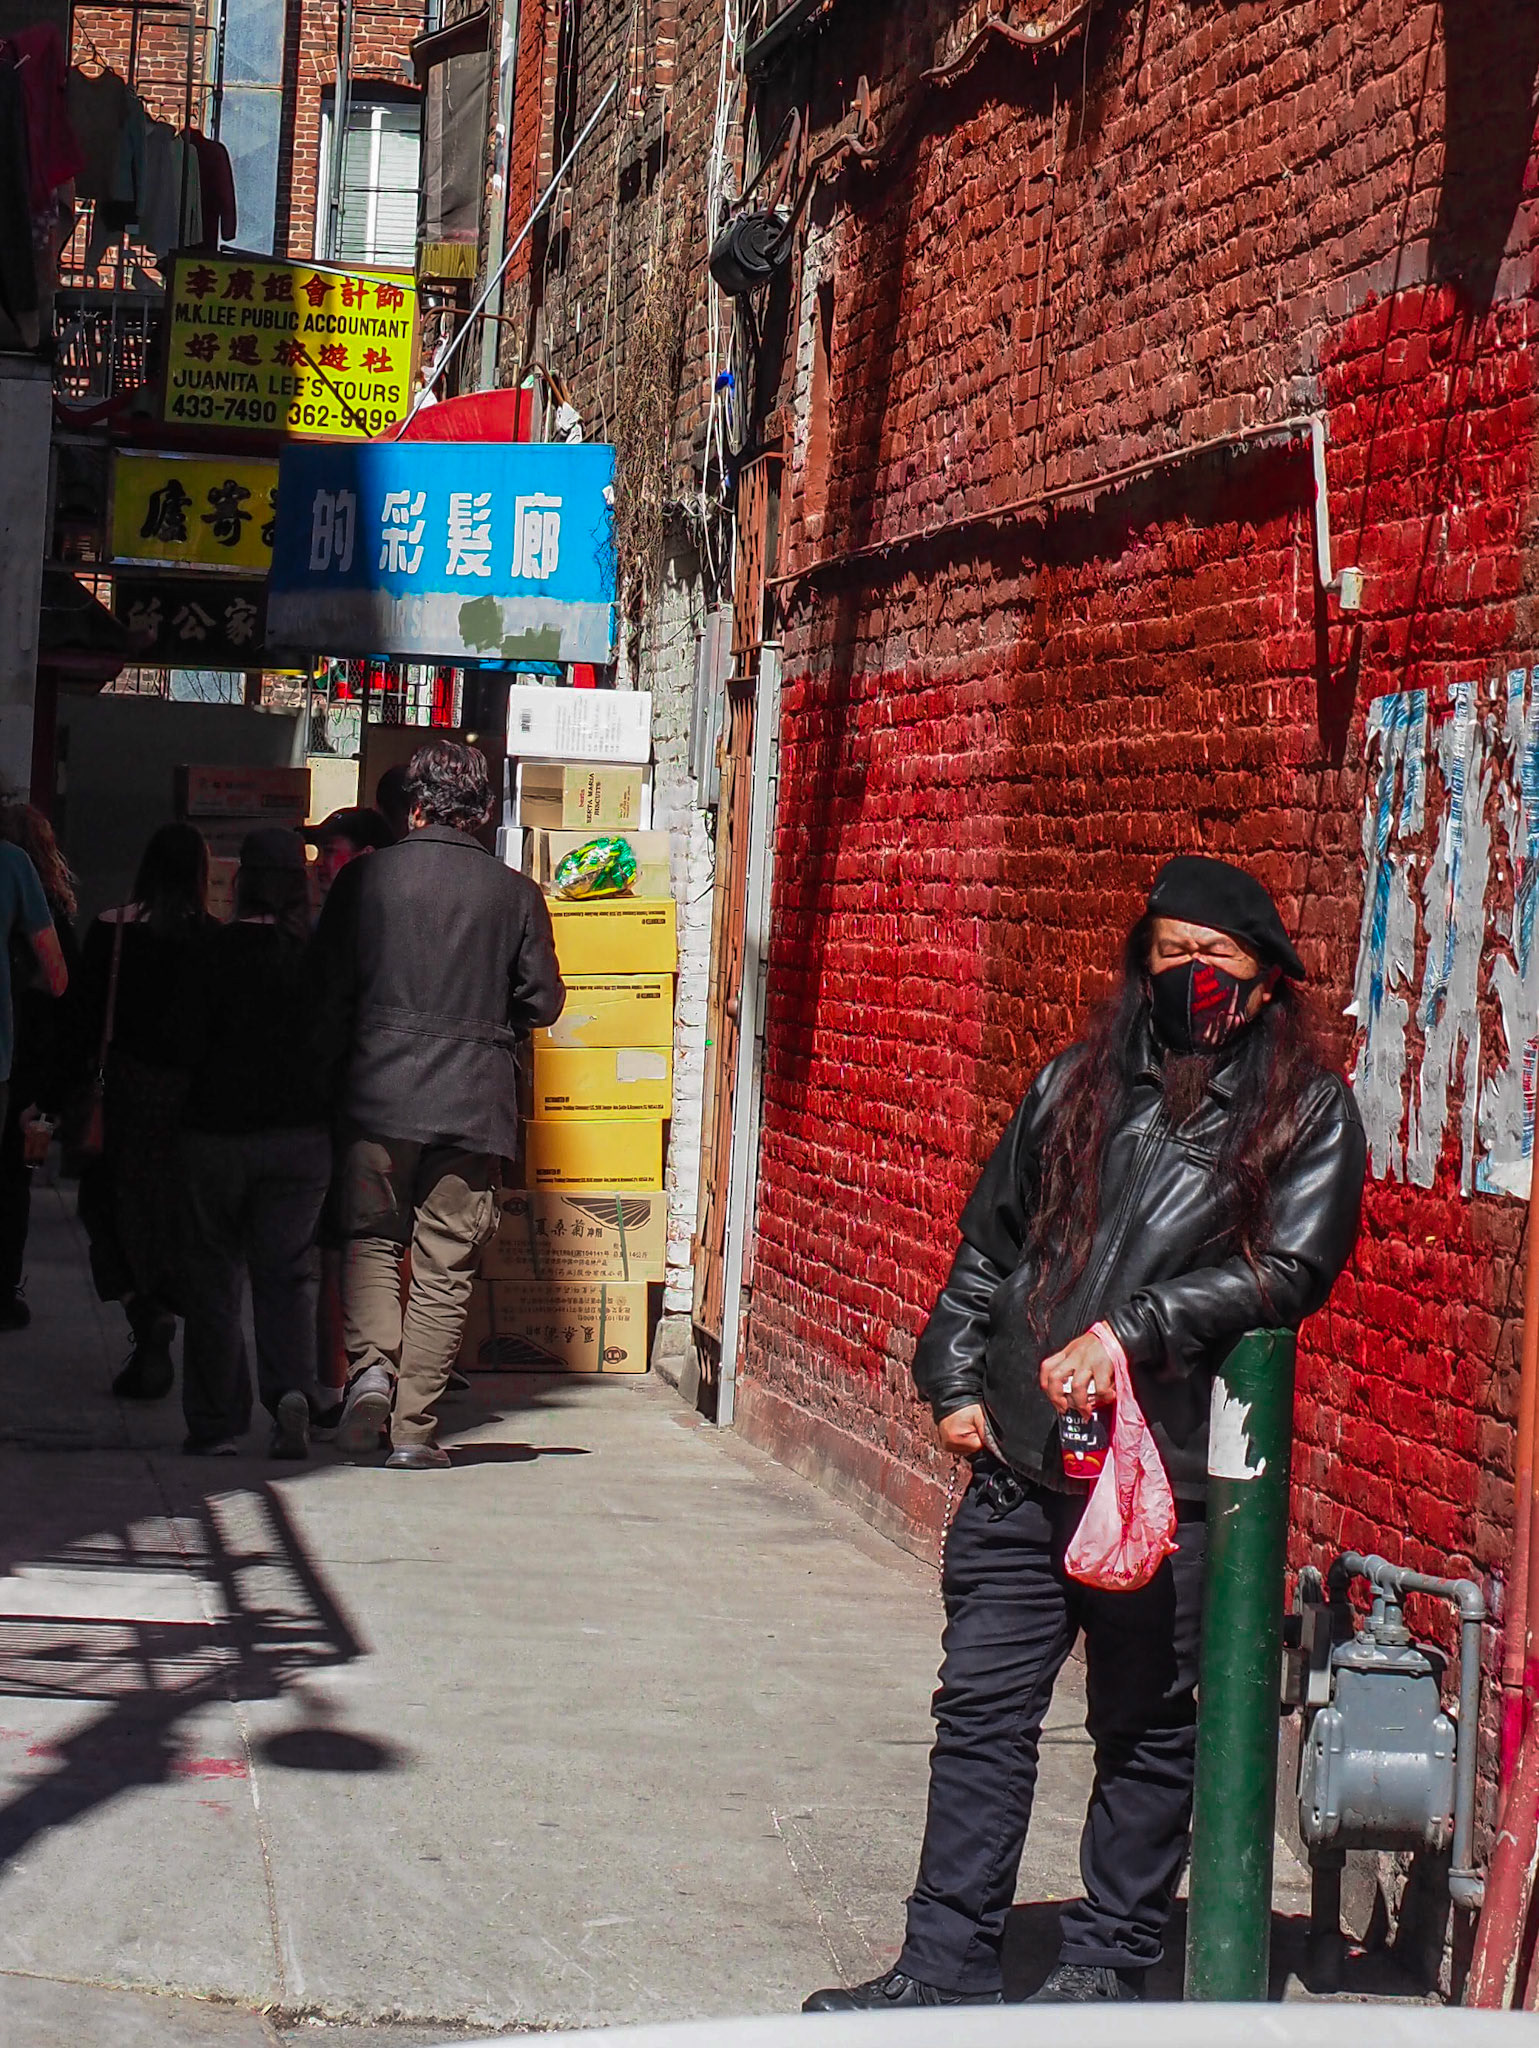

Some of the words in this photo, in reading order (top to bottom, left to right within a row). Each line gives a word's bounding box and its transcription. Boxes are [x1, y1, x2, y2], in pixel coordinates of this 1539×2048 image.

[241, 308, 299, 331] PUBLIC
[303, 313, 410, 339] ACCOUNTANT
[184, 332, 394, 374] 好運旅遊社
[173, 369, 259, 393] JUANITA
[268, 374, 324, 398] LEE'S
[332, 380, 401, 404] TOURS
[172, 394, 277, 423] 433-7490
[308, 488, 563, 580] 的彩髮廊
